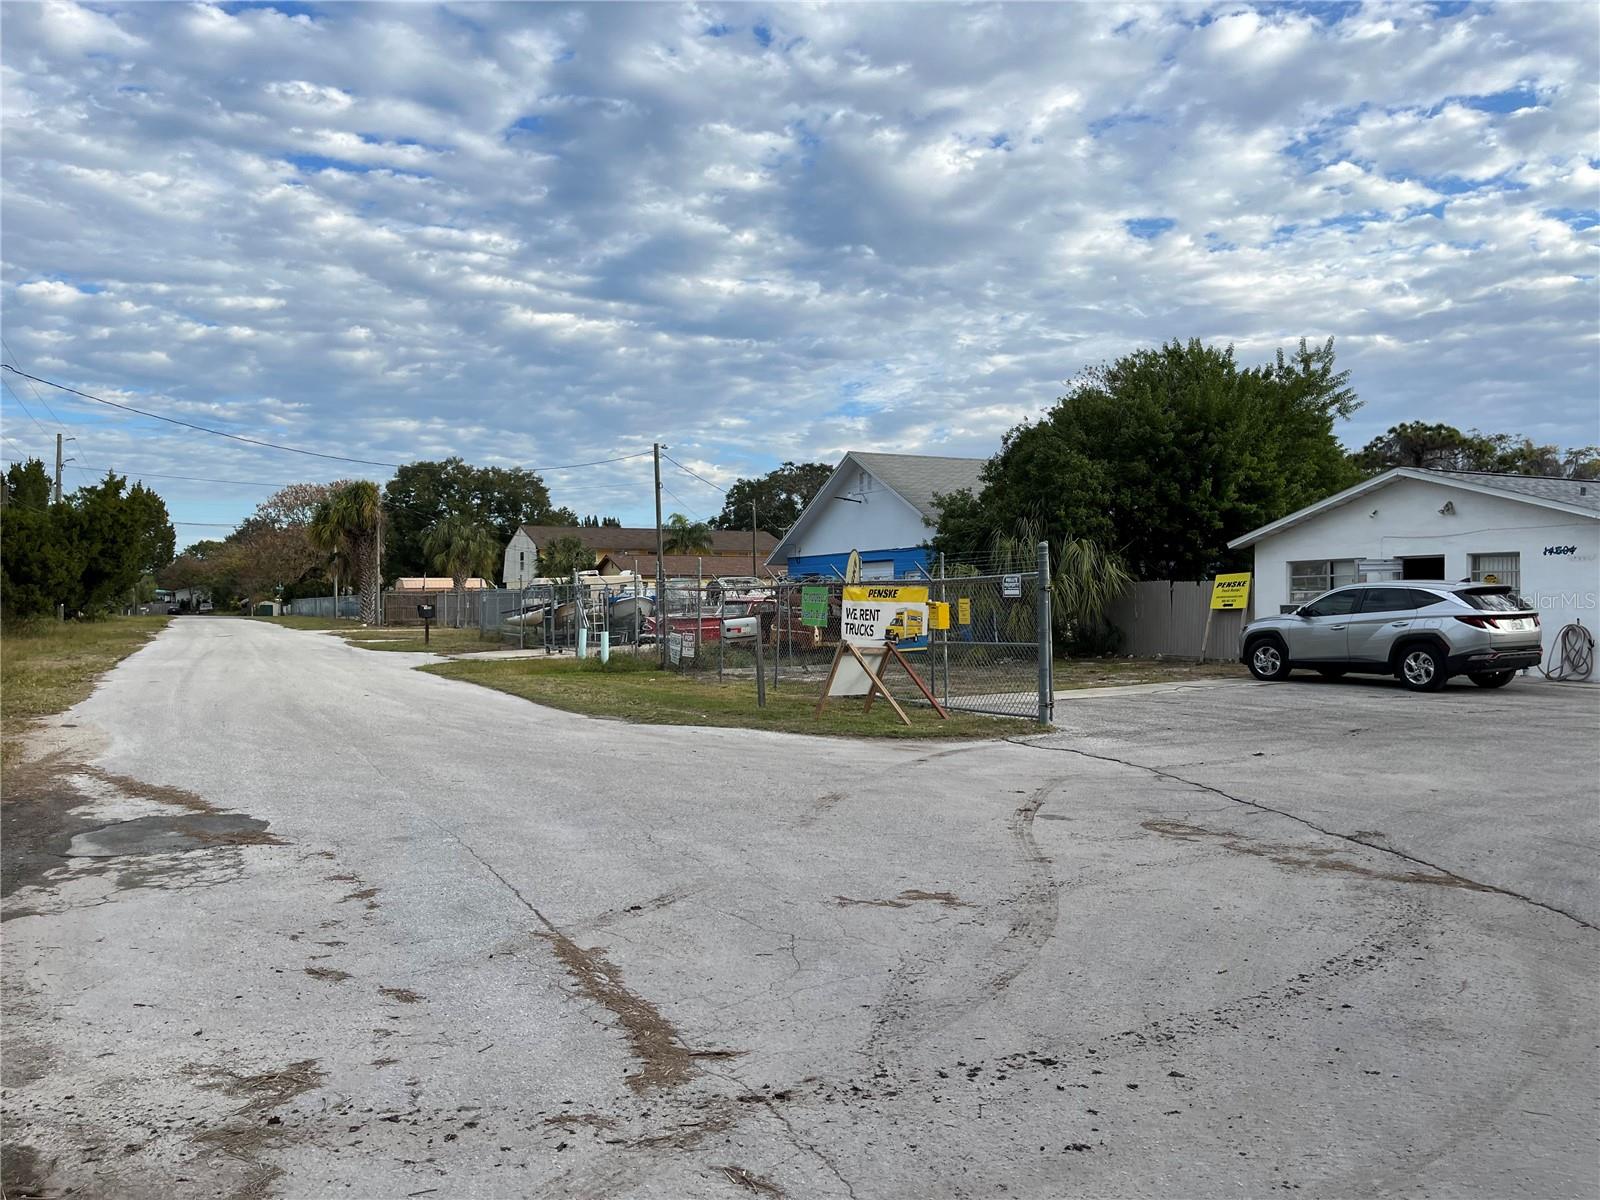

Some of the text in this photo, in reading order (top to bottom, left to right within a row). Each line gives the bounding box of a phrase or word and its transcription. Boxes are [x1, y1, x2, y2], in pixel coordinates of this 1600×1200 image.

[1216, 580, 1247, 588] PENSKE
[867, 589, 899, 599] PENSKE
[845, 607, 881, 622] WE RENT
[844, 622, 875, 637] TRUCKS
